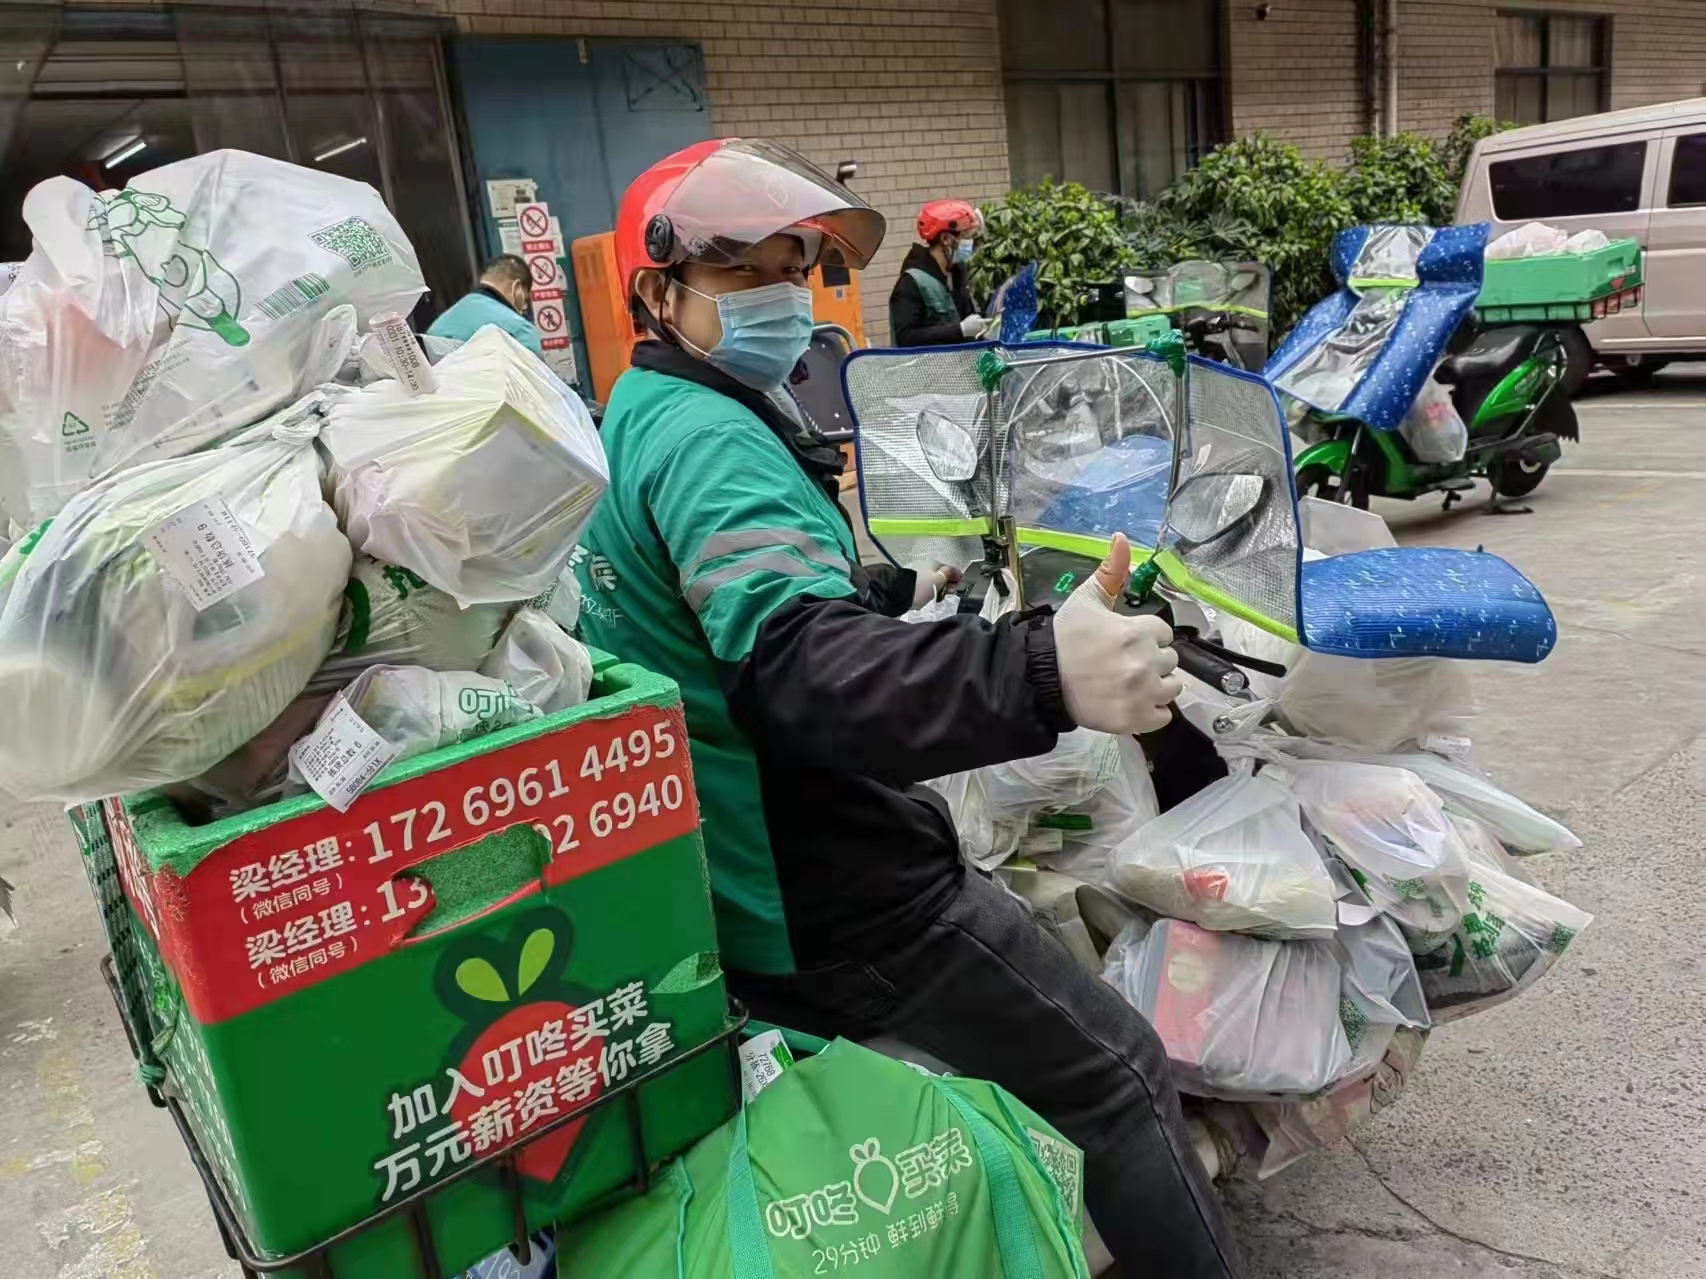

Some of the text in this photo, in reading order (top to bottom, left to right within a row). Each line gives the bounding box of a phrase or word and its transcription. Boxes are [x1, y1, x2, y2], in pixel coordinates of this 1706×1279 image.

[362, 801, 452, 865] 172
[462, 760, 569, 826] 6961
[579, 719, 676, 780] 4495
[589, 774, 683, 838] 6940
[374, 1022, 675, 1201] 万元薪资等你拿
[387, 980, 648, 1139] 加入叮咚买菜
[811, 1232, 881, 1275] 29分钟
